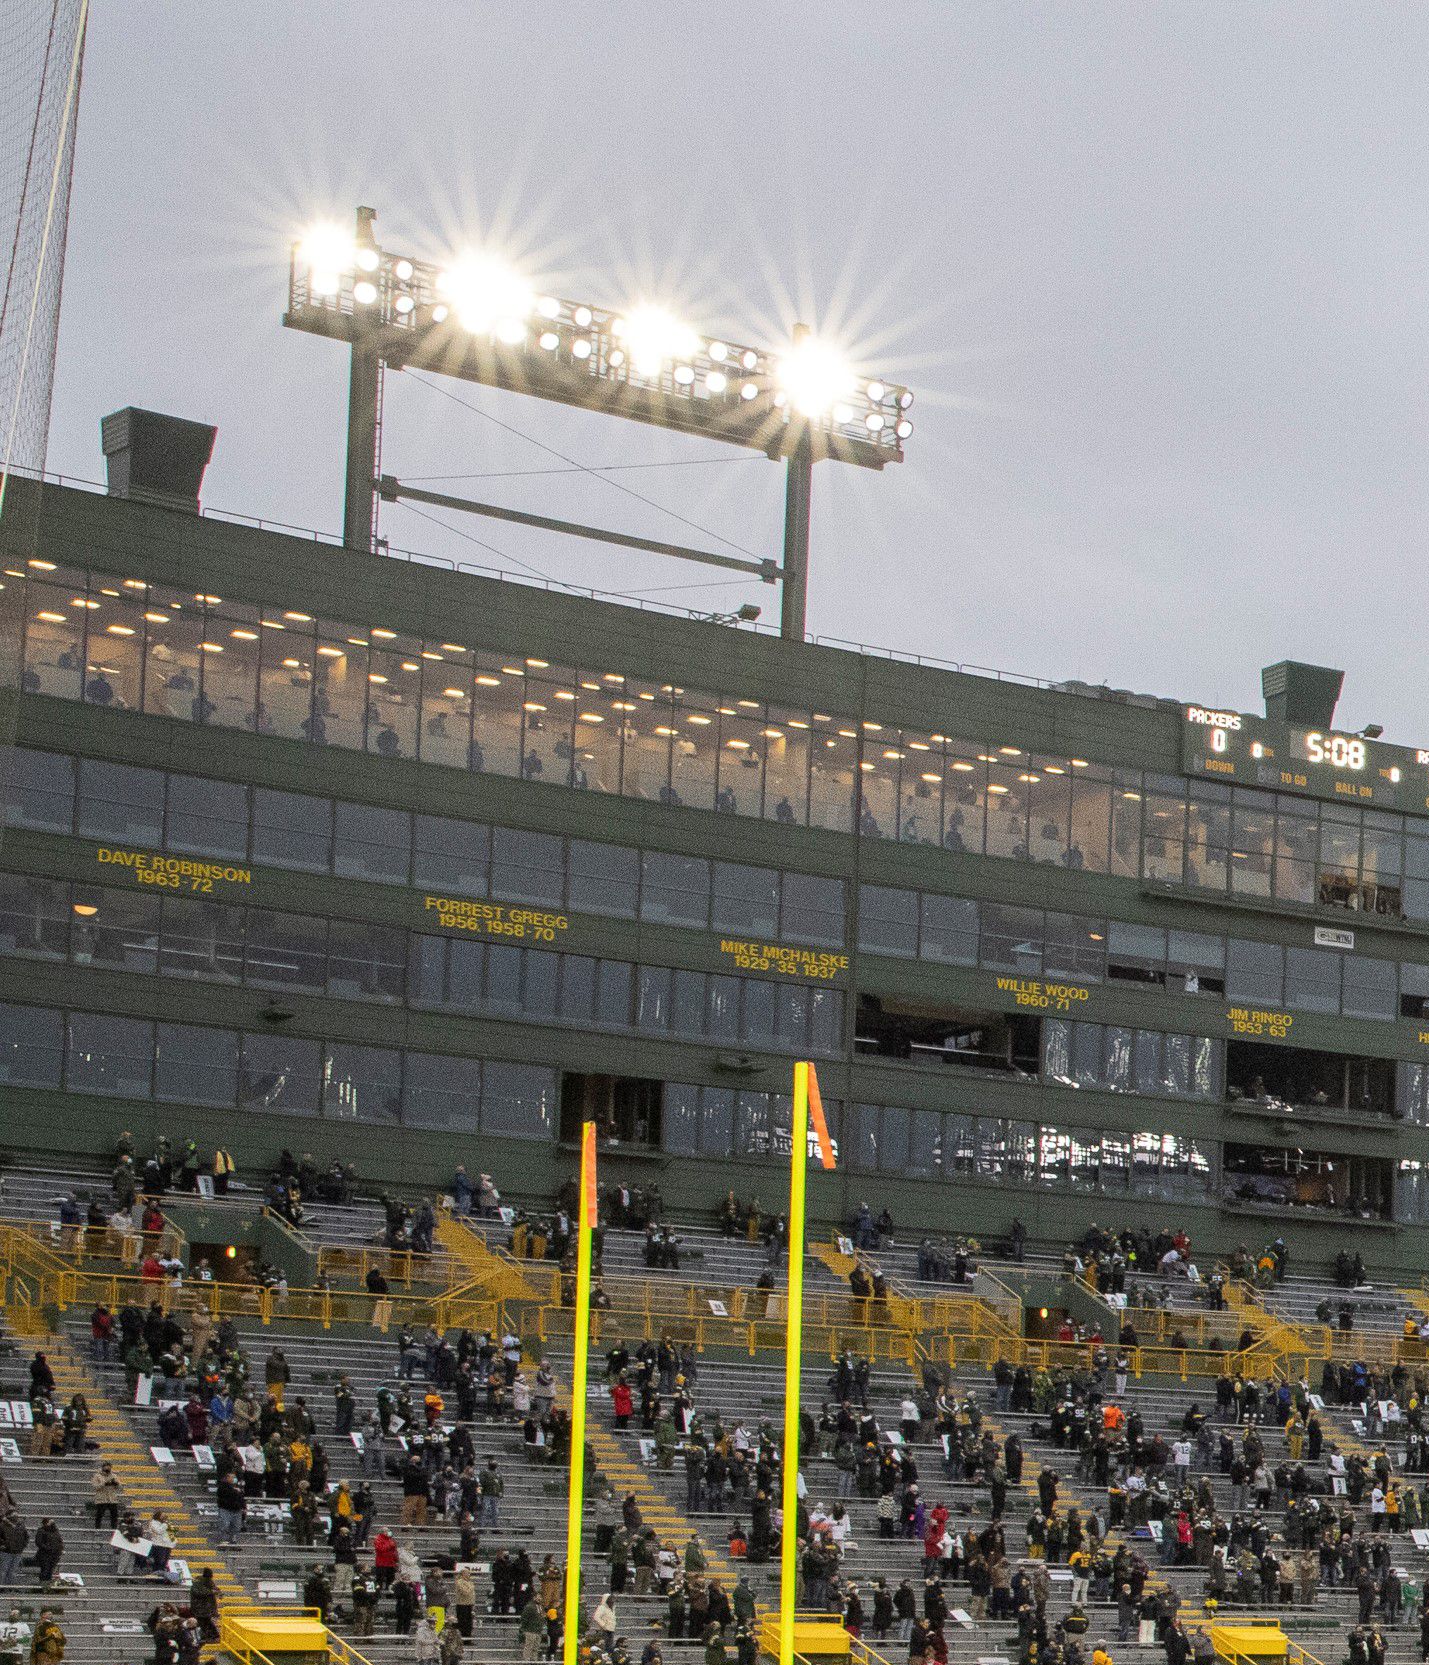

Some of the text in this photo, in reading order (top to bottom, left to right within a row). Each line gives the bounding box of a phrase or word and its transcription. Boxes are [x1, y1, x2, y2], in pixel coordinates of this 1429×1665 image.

[1188, 707, 1242, 731] PACKERS
[1212, 728, 1226, 753] 0
[1307, 732, 1365, 770] 5:08
[1205, 759, 1234, 775] DOWN
[98, 848, 251, 884] DAVE ROBINSON
[135, 869, 213, 893] 1963-72
[426, 896, 569, 931] FORREST GREGG
[487, 920, 555, 942] 1958-70
[720, 939, 849, 970] MIKE MICHALSKE
[803, 963, 836, 980] 1937
[997, 977, 1089, 1001] WILLIE WOOD
[1015, 993, 1070, 1011] 1960-71
[1226, 1008, 1293, 1029] JIM RINGO
[1232, 1020, 1287, 1038] 1953-63
